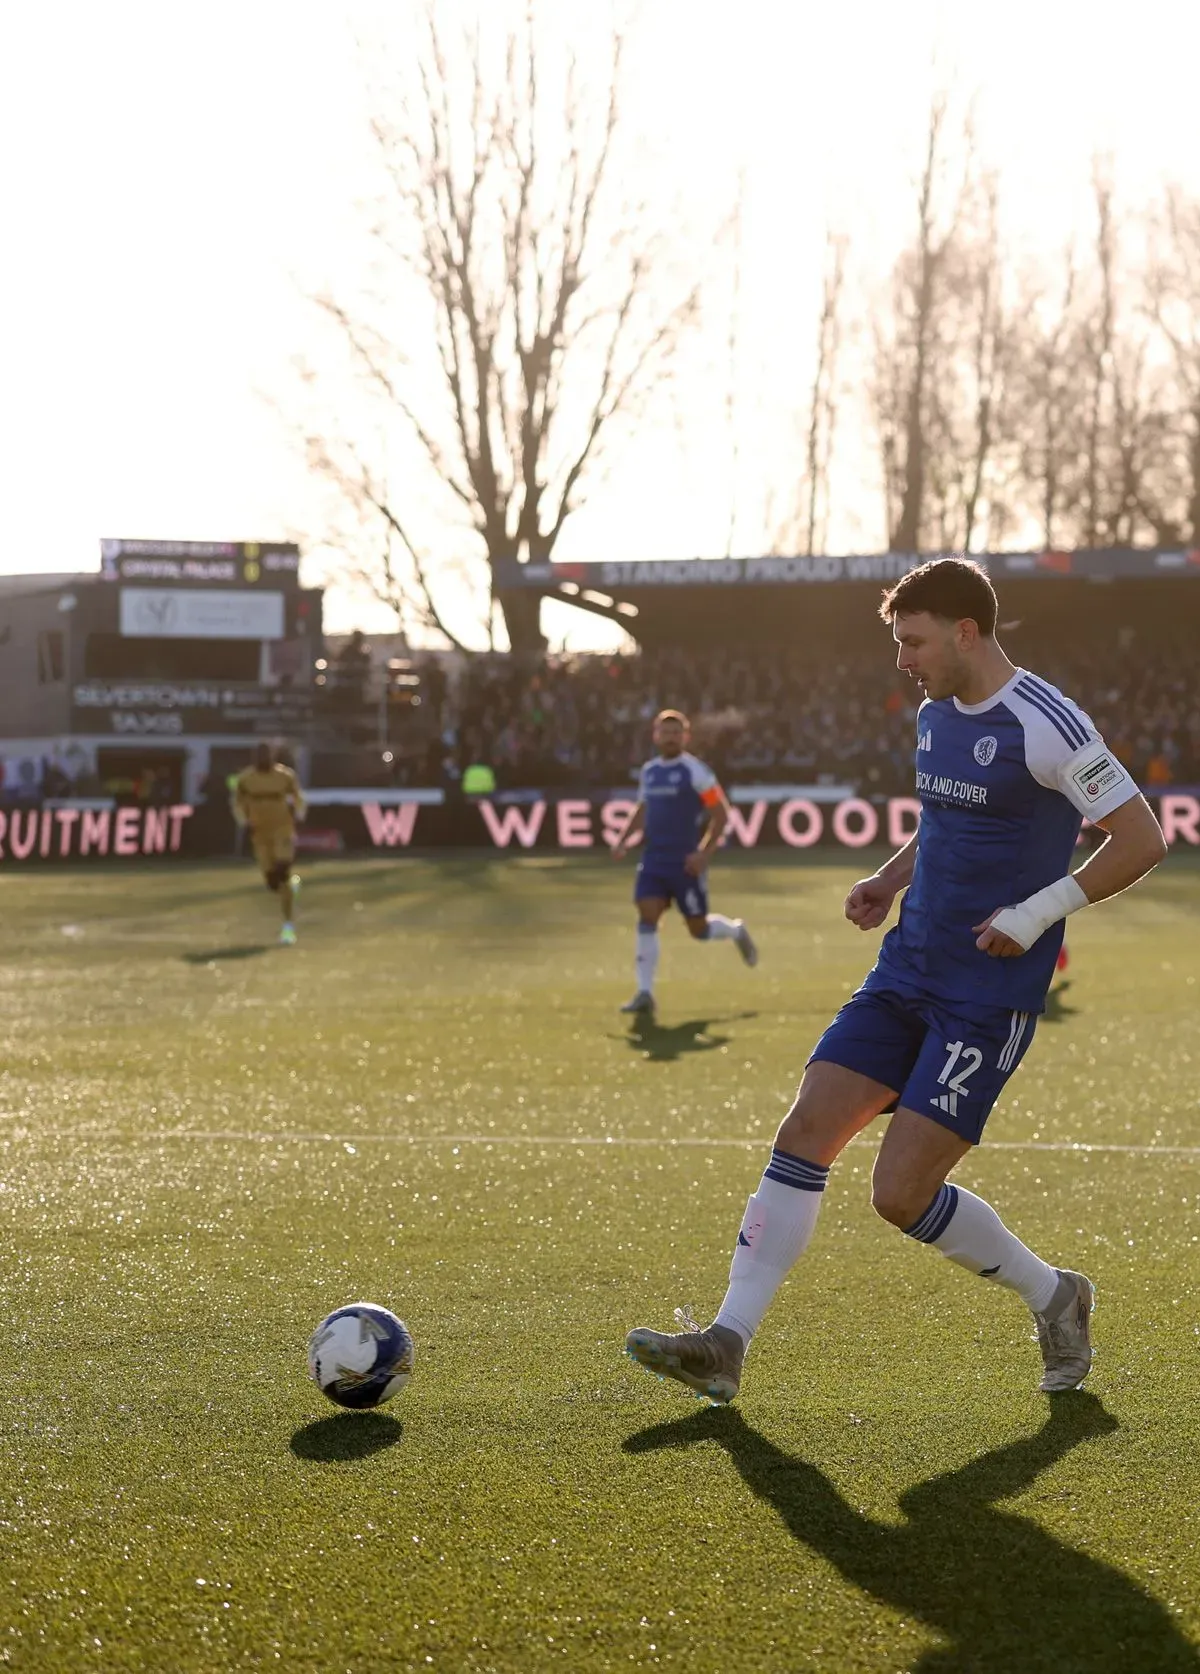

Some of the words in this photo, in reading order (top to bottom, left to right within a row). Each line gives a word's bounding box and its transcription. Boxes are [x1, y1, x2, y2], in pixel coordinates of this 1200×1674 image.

[603, 558, 741, 587] STANDING
[744, 556, 840, 585] PROUD
[931, 775, 953, 795] AND
[952, 780, 987, 805] COVER
[0, 804, 194, 860] UITMENT
[480, 797, 921, 847] WESWOOD
[937, 1040, 983, 1097] 12
